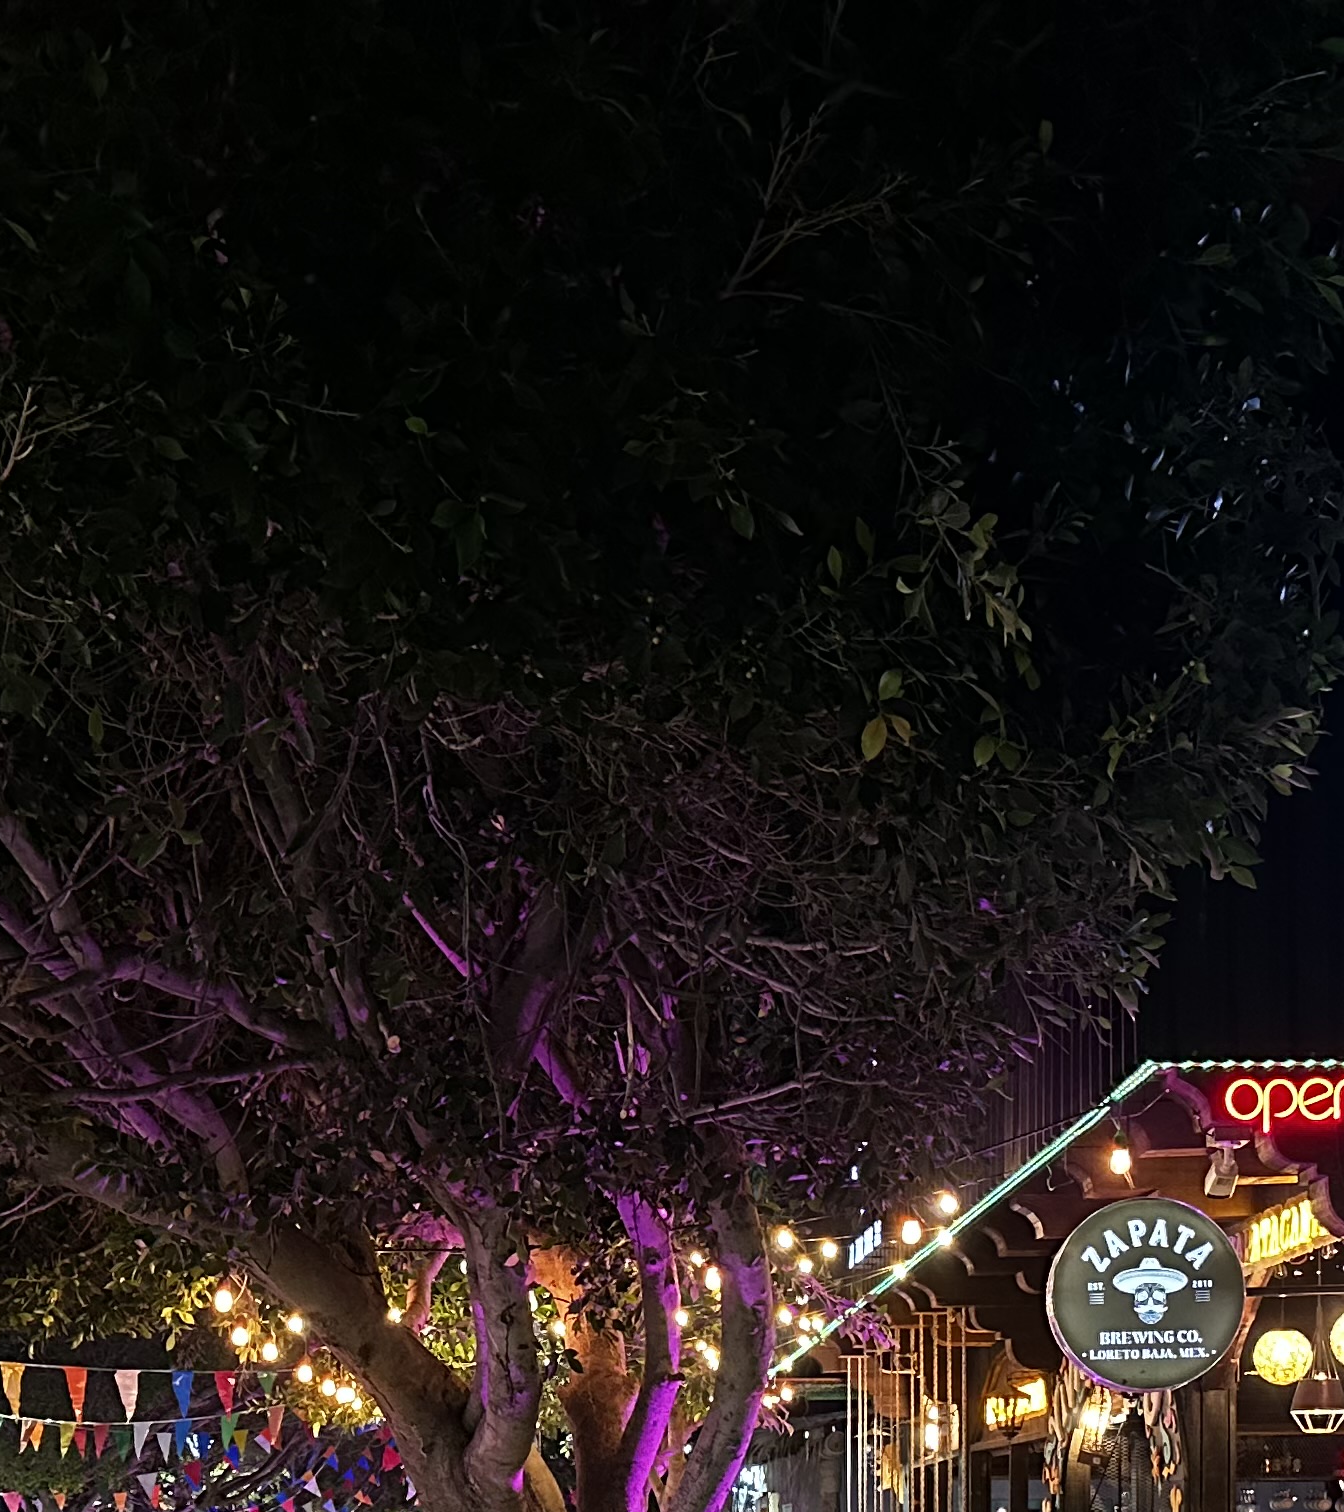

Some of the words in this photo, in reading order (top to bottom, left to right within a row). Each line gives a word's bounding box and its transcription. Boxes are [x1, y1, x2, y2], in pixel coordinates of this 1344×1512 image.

[1081, 1219, 1214, 1273] ZAPATA
[1099, 1330, 1175, 1346] BREWING
[1089, 1349, 1141, 1361] LORETO
